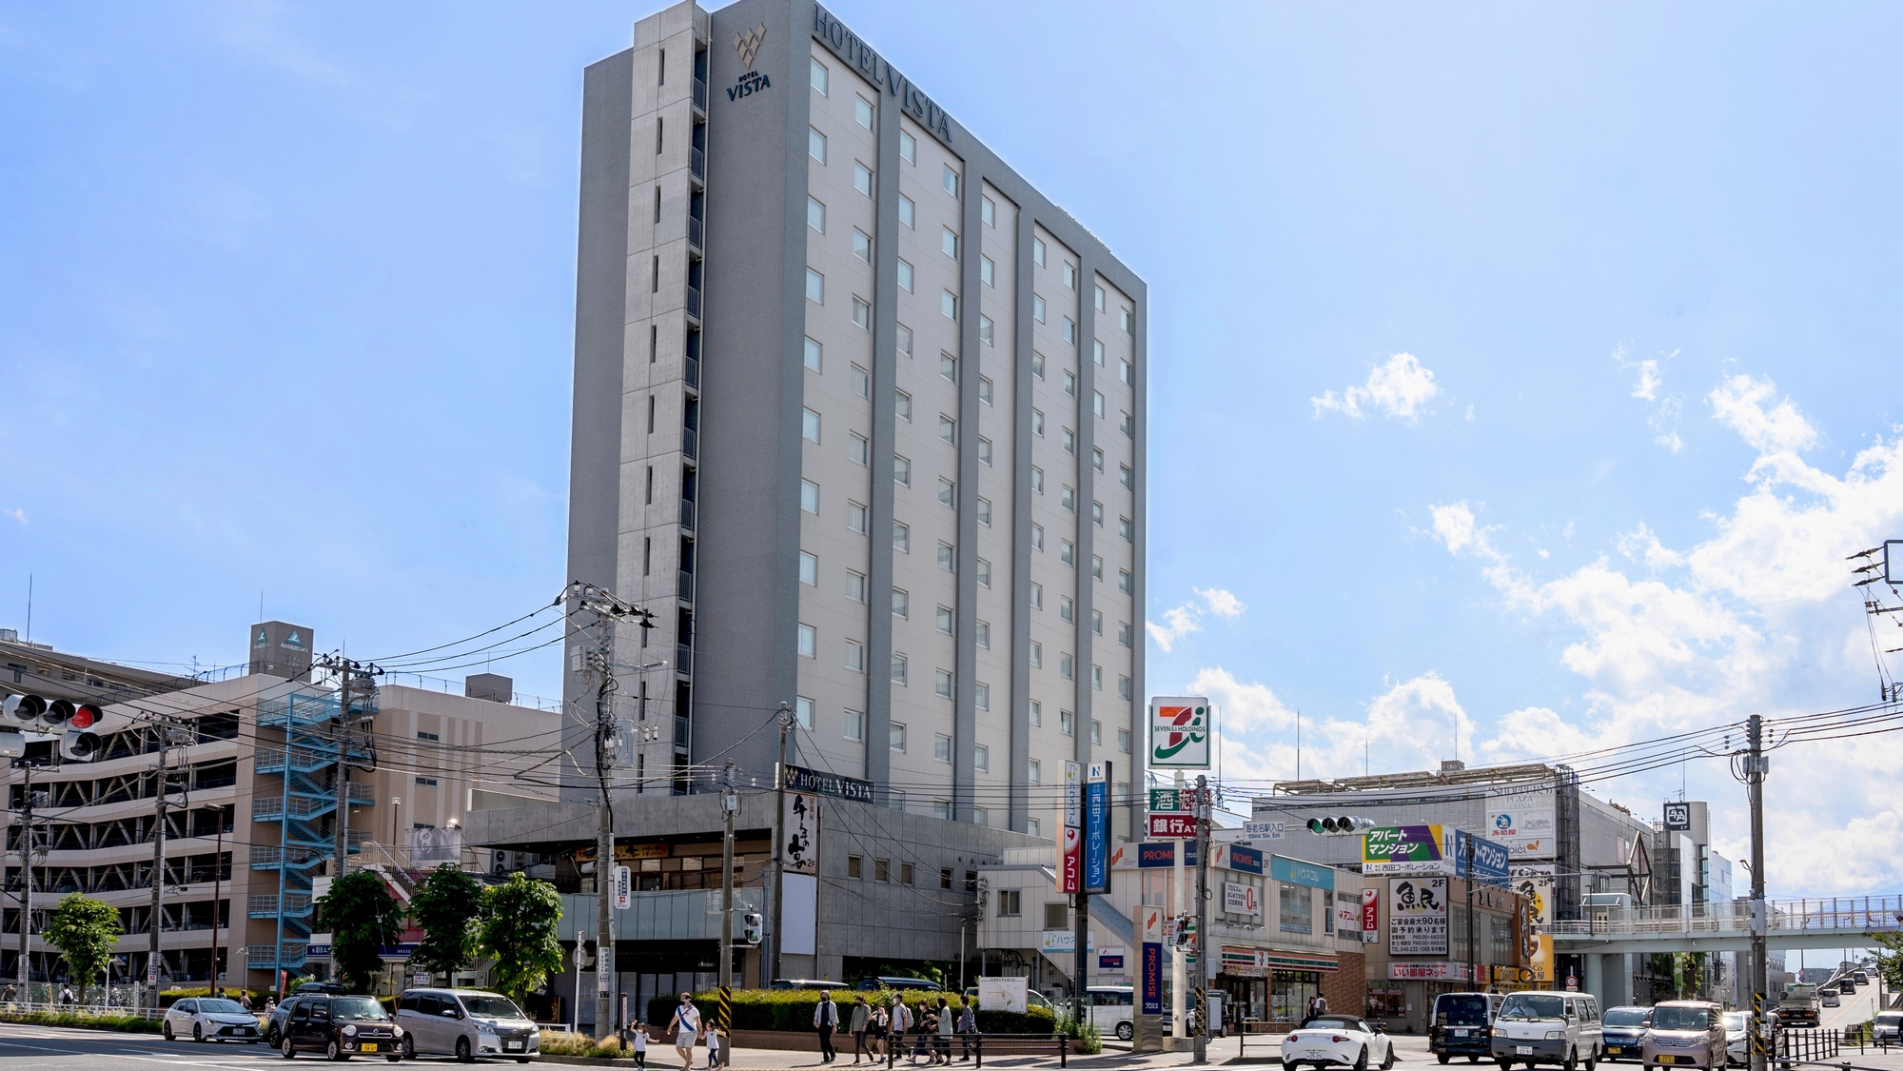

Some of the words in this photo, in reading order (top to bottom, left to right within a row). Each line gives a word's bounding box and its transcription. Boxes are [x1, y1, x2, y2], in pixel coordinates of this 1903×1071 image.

[738, 70, 759, 83] HOTEL
[814, 4, 883, 85] HOTEL
[885, 60, 952, 143] VISTA
[726, 74, 771, 102] VISTA
[1178, 725, 1206, 733] HOLDINGS
[800, 773, 835, 793] HOTEL
[836, 779, 871, 800] VISTA
[1155, 791, 1174, 810] 酒
[1507, 795, 1533, 803] PLAZA
[1245, 824, 1284, 833] 海老名駅入口
[1092, 793, 1101, 885] 西田コーポレーション
[1368, 829, 1408, 842] アパート
[1143, 850, 1174, 861] PROMI
[1368, 843, 1419, 855] マンション
[807, 859, 815, 867] 2F
[1232, 852, 1252, 865] PROMISE
[1263, 859, 1270, 868] 2F
[1067, 856, 1076, 891] アコム
[1382, 863, 1441, 871] 西田コーポレーション
[1297, 868, 1319, 882] ハウスコム
[1432, 879, 1444, 888] 2F
[1396, 881, 1439, 911] 魚民
[1366, 907, 1374, 929] アコム
[1391, 917, 1446, 925] ご宴会最大90名様
[1148, 947, 1156, 998] PROMISE
[1393, 968, 1447, 977] いい部屋ネット
